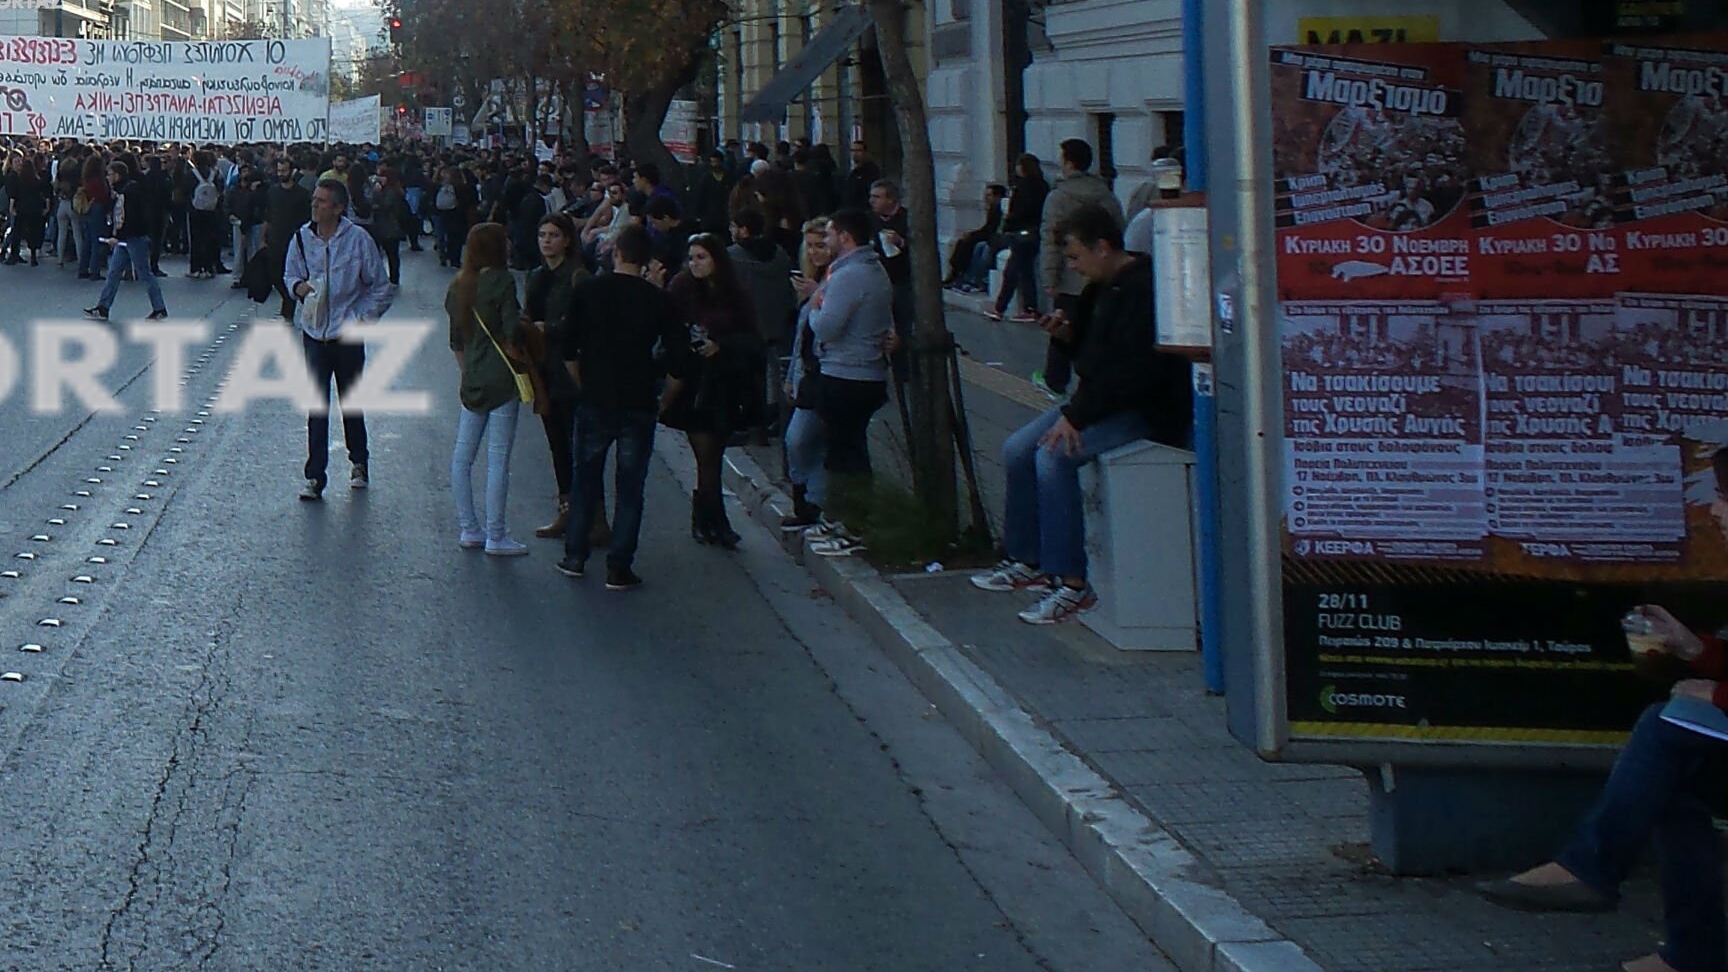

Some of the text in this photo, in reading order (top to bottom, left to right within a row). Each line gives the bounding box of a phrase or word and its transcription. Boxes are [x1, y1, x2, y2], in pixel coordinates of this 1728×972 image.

[1306, 70, 1447, 117] Μαρξισμό
[1285, 235, 1469, 254] ΚΥΡΙΑΚΗ 30 ΝΟΕΜΒΡΗ
[1552, 234, 1581, 252] 30
[1701, 227, 1728, 247] 30
[1389, 256, 1469, 276] ΑΣΟΕΕ
[1586, 254, 1621, 274] ΑΣ
[1290, 371, 1441, 394] Να τσακίσουμε
[1292, 393, 1407, 413] τους νεοναζί
[1292, 413, 1466, 436] της Χρυσής Αυγής
[1317, 593, 1368, 610] 28/11
[1318, 613, 1402, 630] FUZZ CLUB
[1327, 692, 1407, 709] COSMOTE
